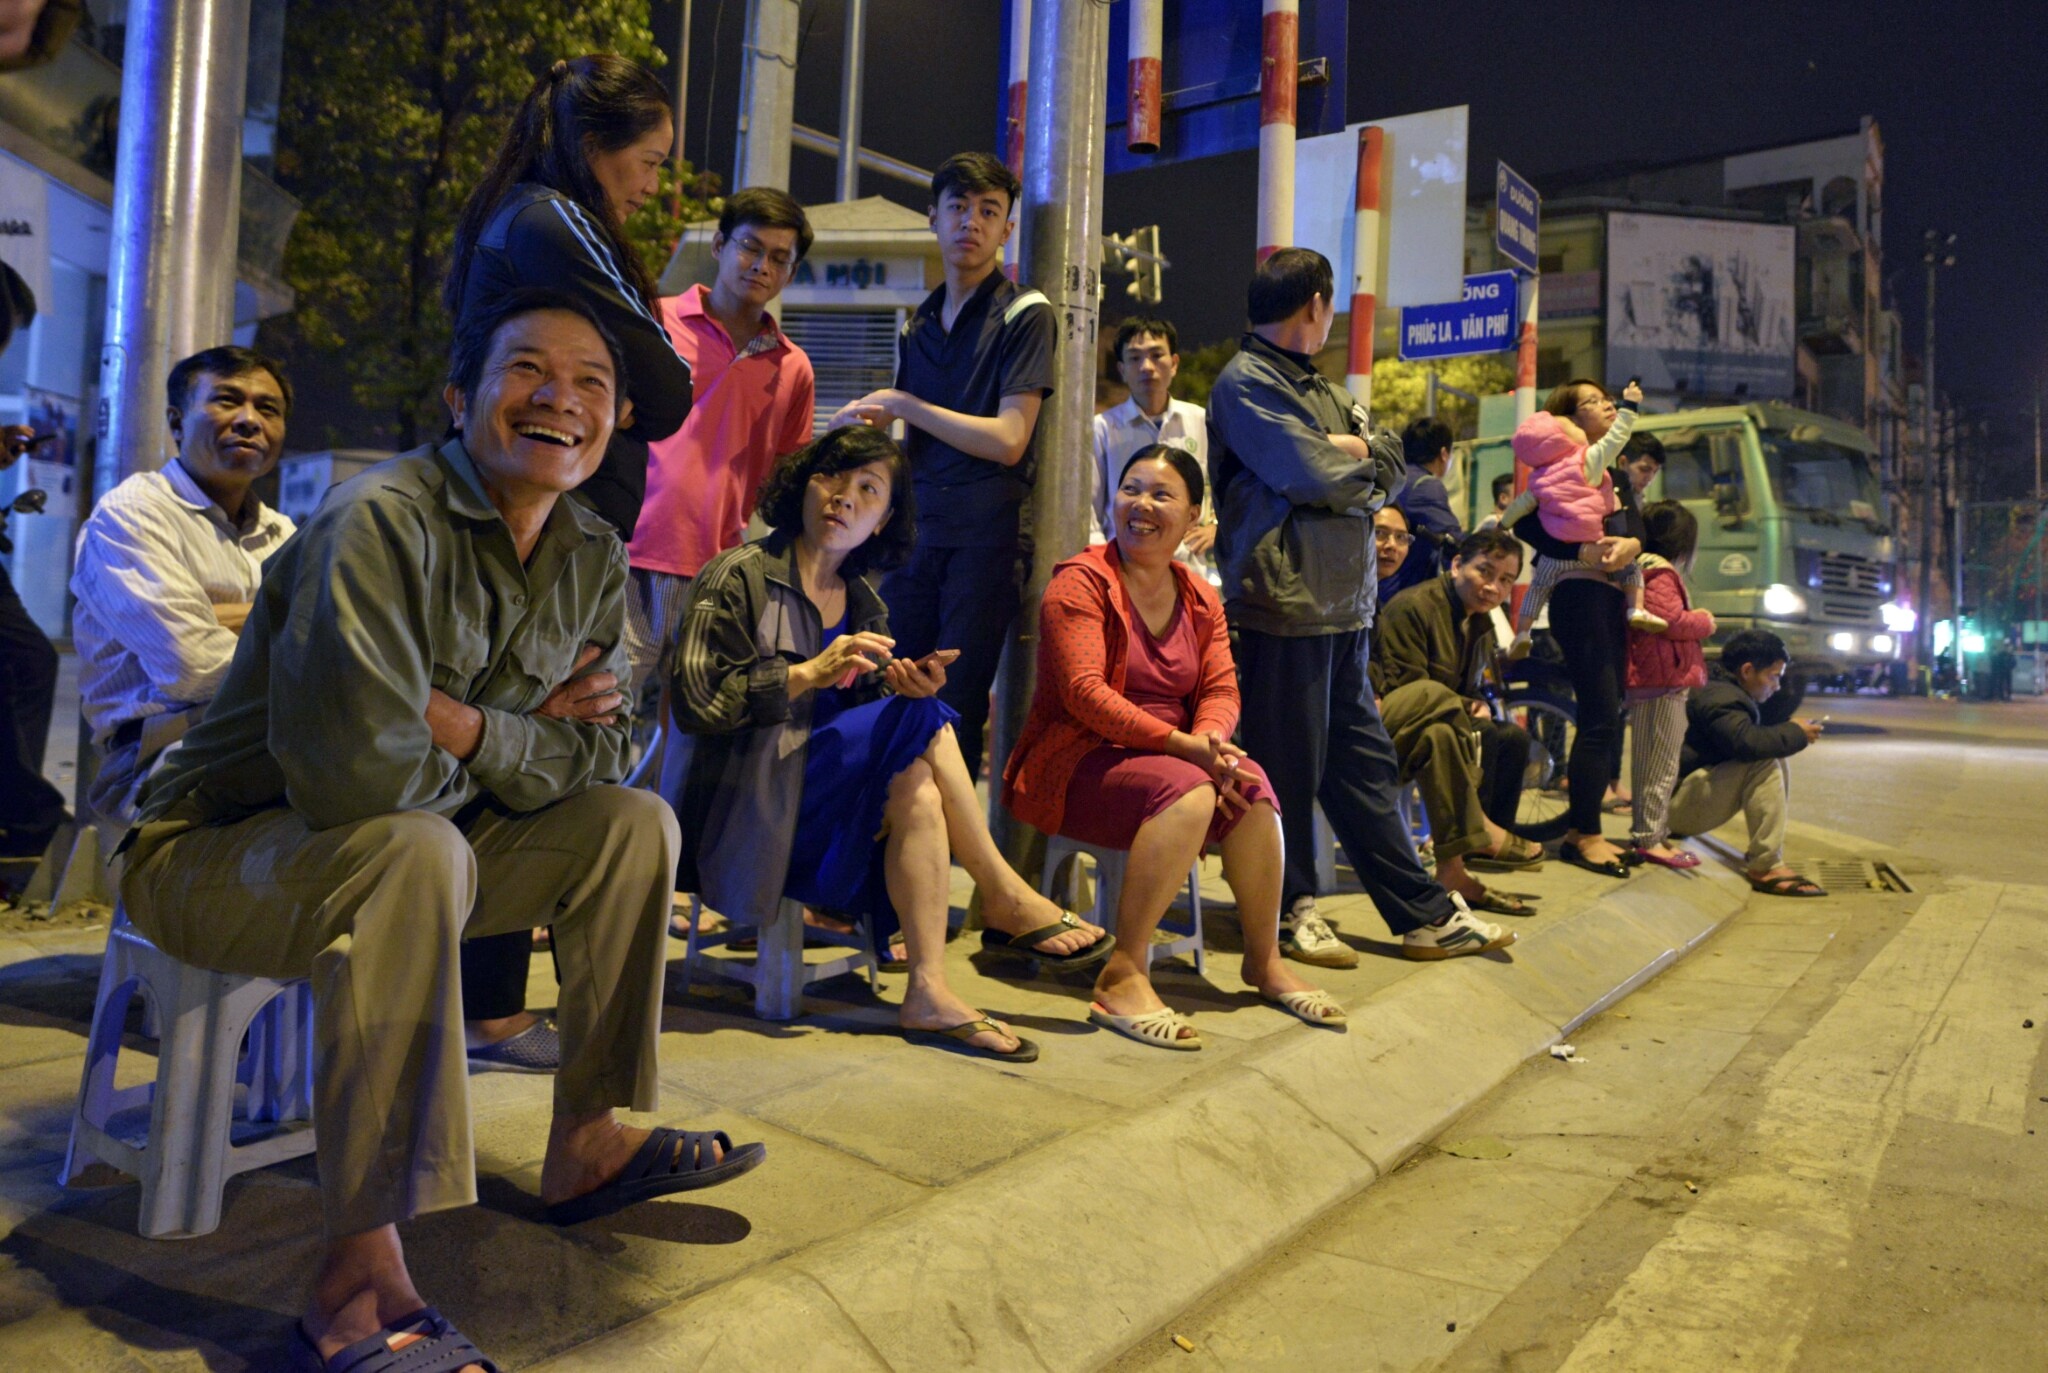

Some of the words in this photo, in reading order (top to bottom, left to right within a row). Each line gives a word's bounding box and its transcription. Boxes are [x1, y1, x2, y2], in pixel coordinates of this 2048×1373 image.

[1408, 318, 1436, 345] PHÚC
[1439, 321, 1452, 342] LA
[1462, 313, 1484, 341] VĂN
[1487, 309, 1508, 337] PHÚ
